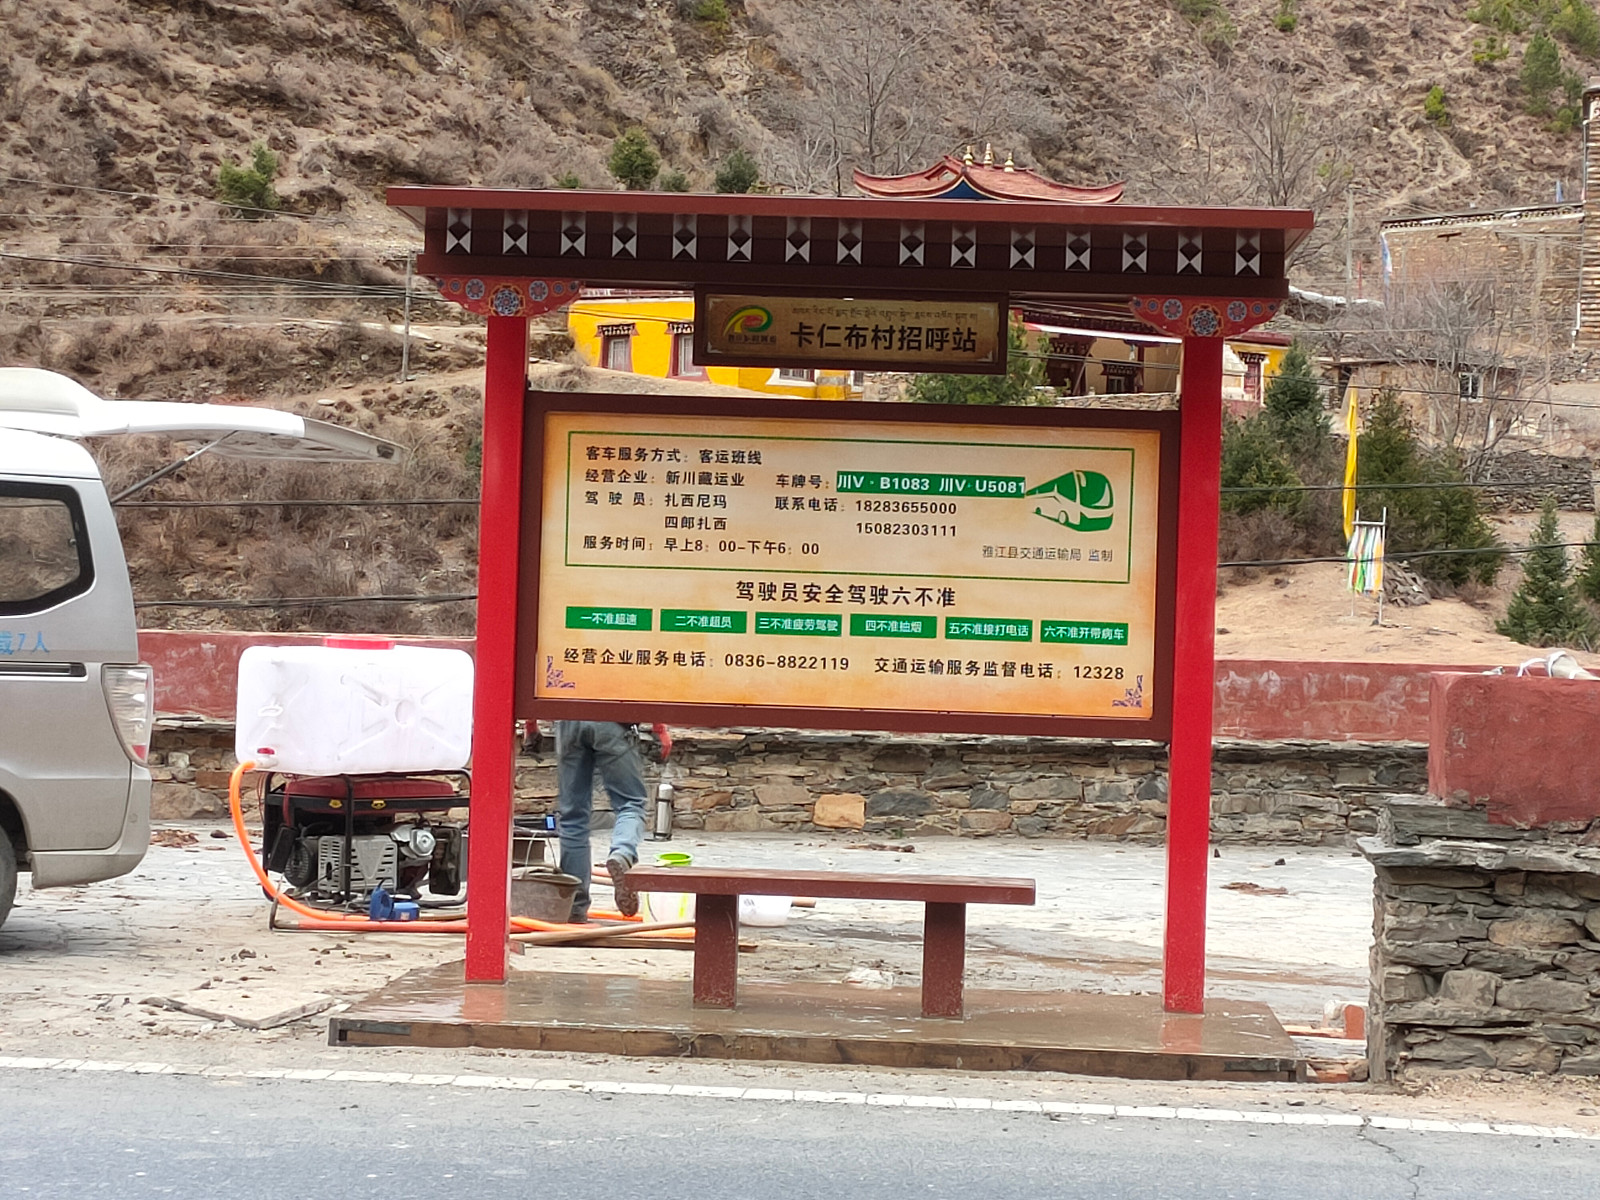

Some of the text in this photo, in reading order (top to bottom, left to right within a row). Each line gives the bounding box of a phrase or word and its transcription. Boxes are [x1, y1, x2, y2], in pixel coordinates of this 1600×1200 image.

[790, 321, 977, 353] 卡仁布村招呼站
[585, 446, 762, 465] 客车服务方式：客运班线
[585, 468, 745, 487] 经营企业：新川藏运业
[664, 516, 728, 531] 四郎扎西
[856, 522, 957, 537] 15082303111
[982, 545, 1113, 563] 雅江县交通运输局 监制
[736, 580, 956, 607] 驾驶员安全驾驶六不准
[581, 612, 638, 626] 一不准超速
[675, 614, 732, 629] 二不准超员
[758, 617, 838, 632] 三不准疲劳驾驶
[865, 619, 922, 633] 四不准抽烟
[948, 622, 1029, 637] 五不准接打电话
[1044, 625, 1125, 641] 六不准开带病车
